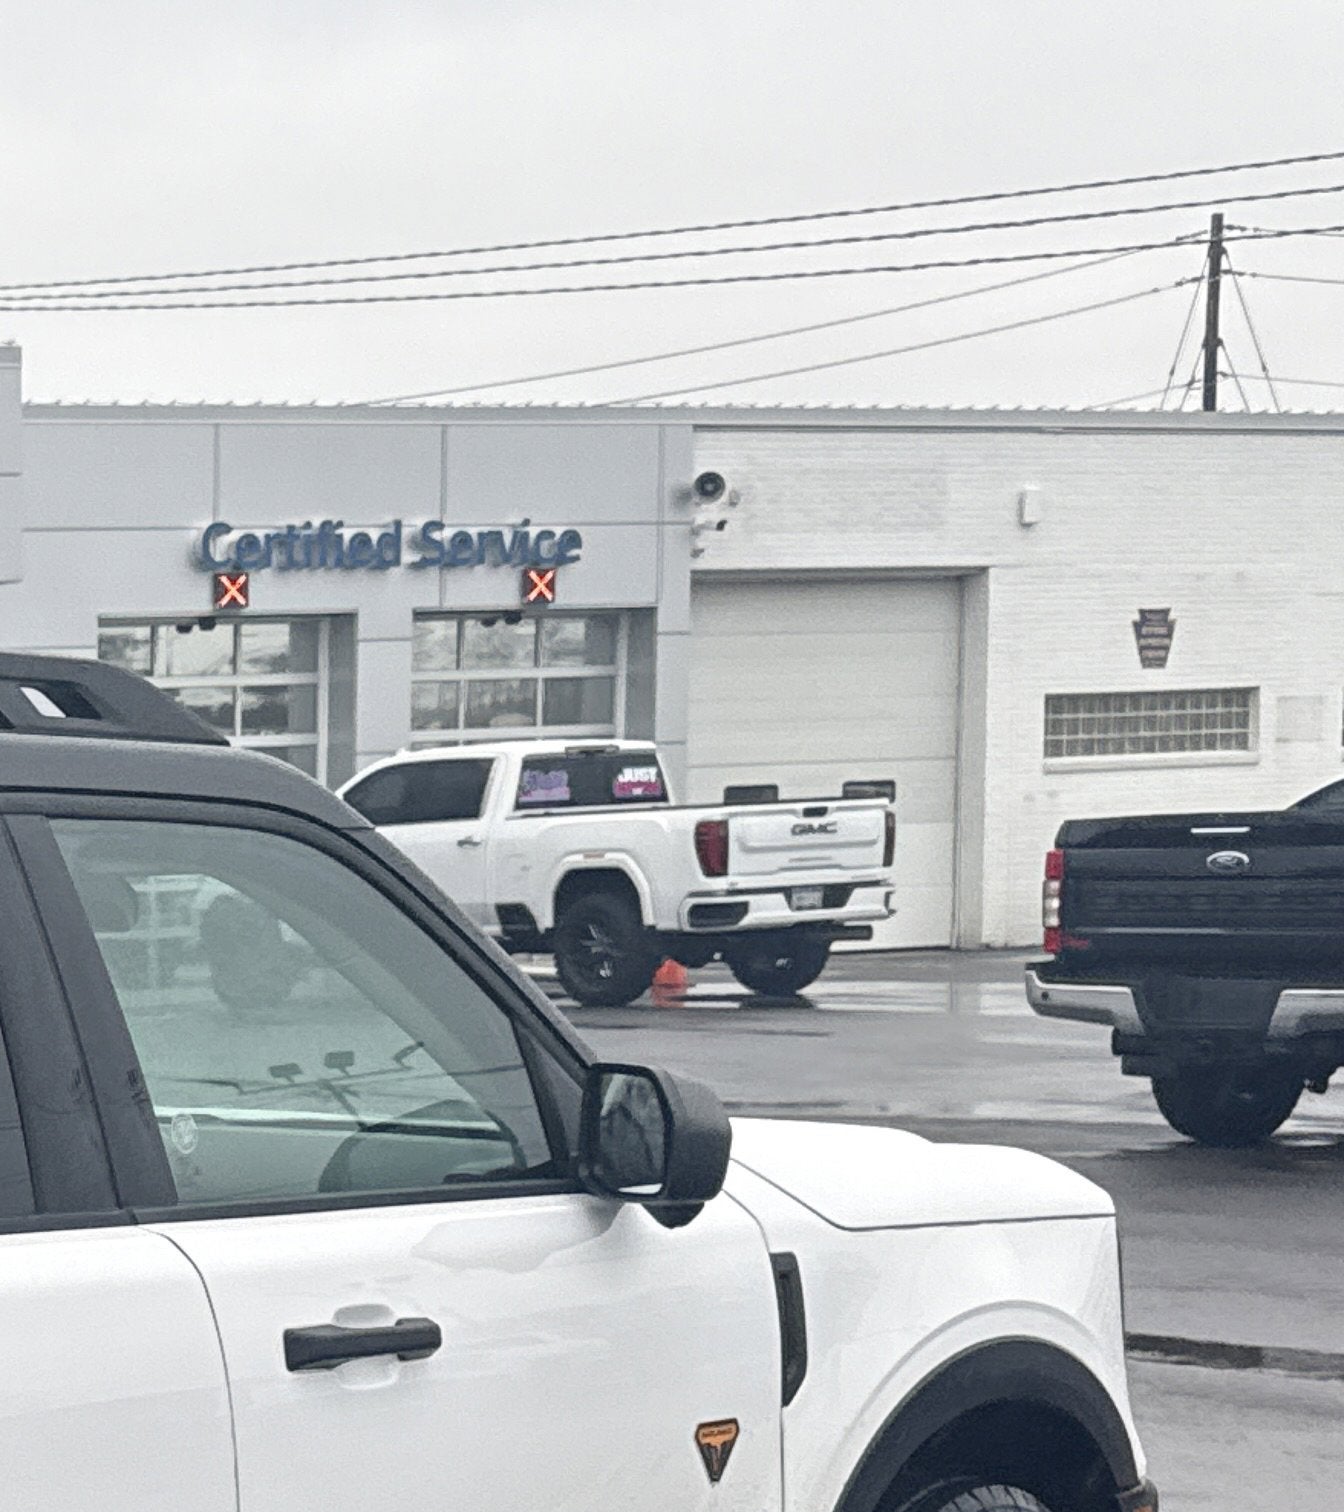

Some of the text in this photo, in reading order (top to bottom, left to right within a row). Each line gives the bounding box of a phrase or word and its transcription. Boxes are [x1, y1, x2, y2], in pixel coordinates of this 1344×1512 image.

[201, 518, 583, 571] Certified Service
[790, 820, 838, 836] GMC
